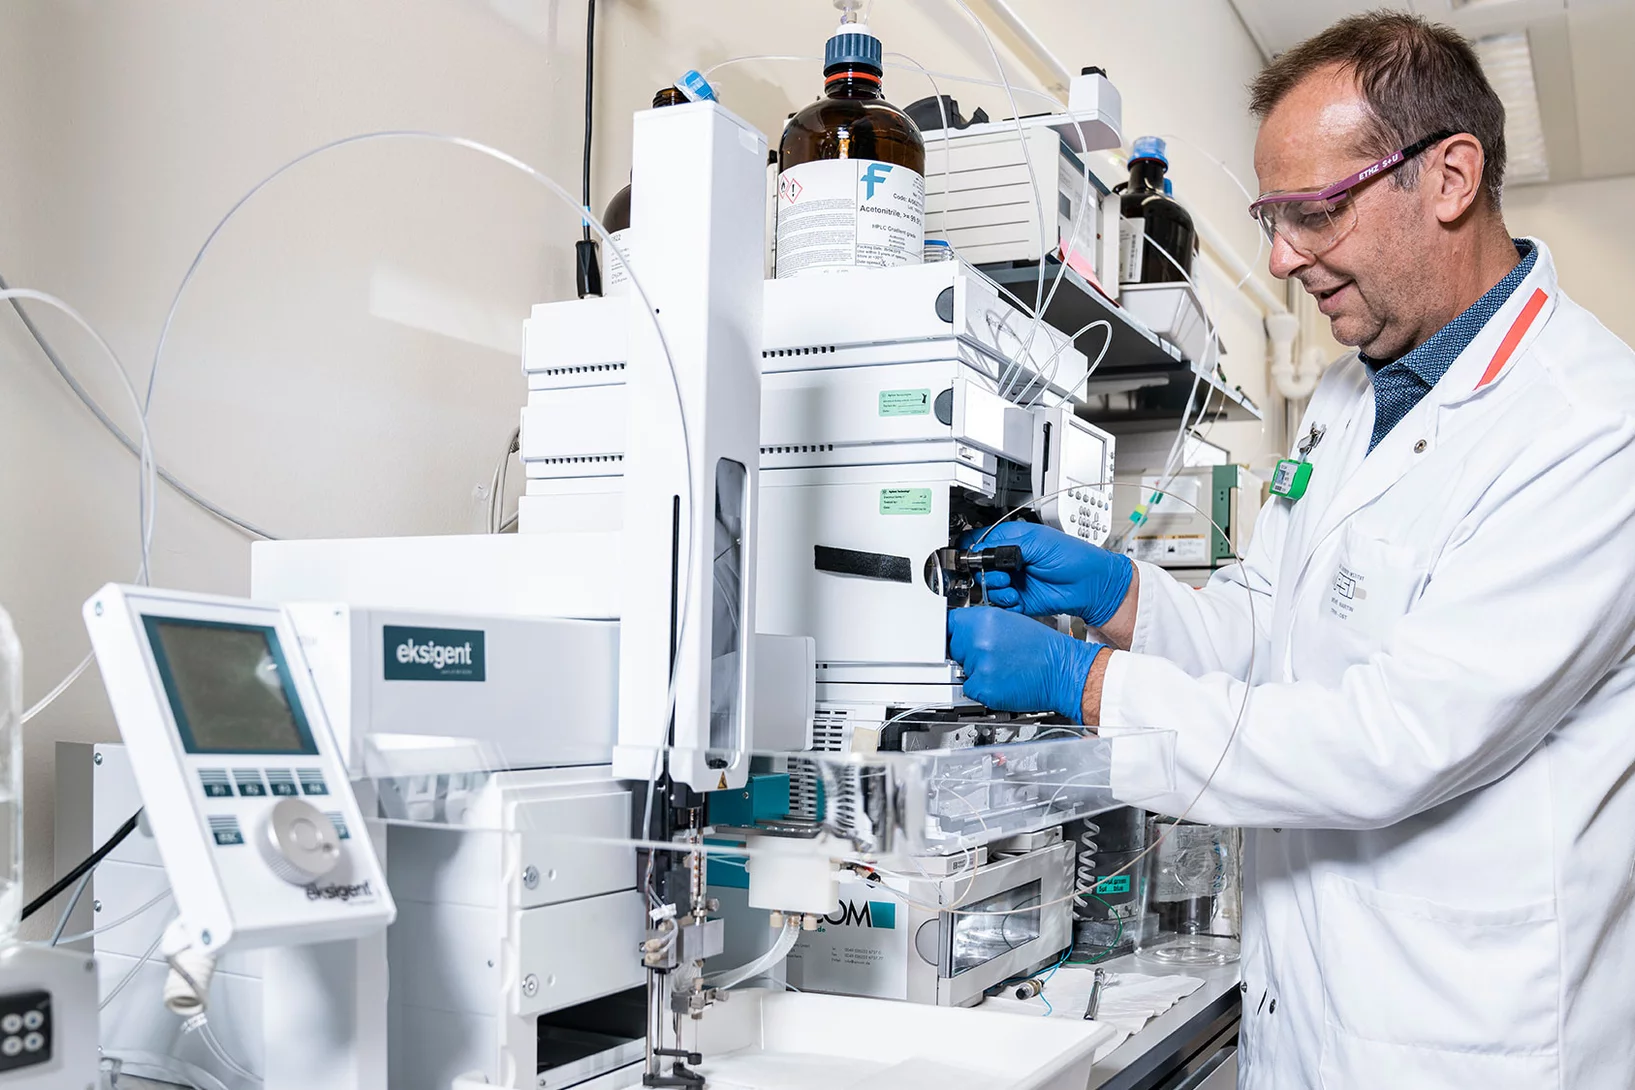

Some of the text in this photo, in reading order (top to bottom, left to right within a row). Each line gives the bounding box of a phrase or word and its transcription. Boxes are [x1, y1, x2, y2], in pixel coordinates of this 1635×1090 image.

[1358, 154, 1398, 181] ETHZ S+U
[860, 205, 902, 219] Acetonitrile,
[396, 638, 472, 669] eksigent
[306, 881, 372, 901] eksigent
